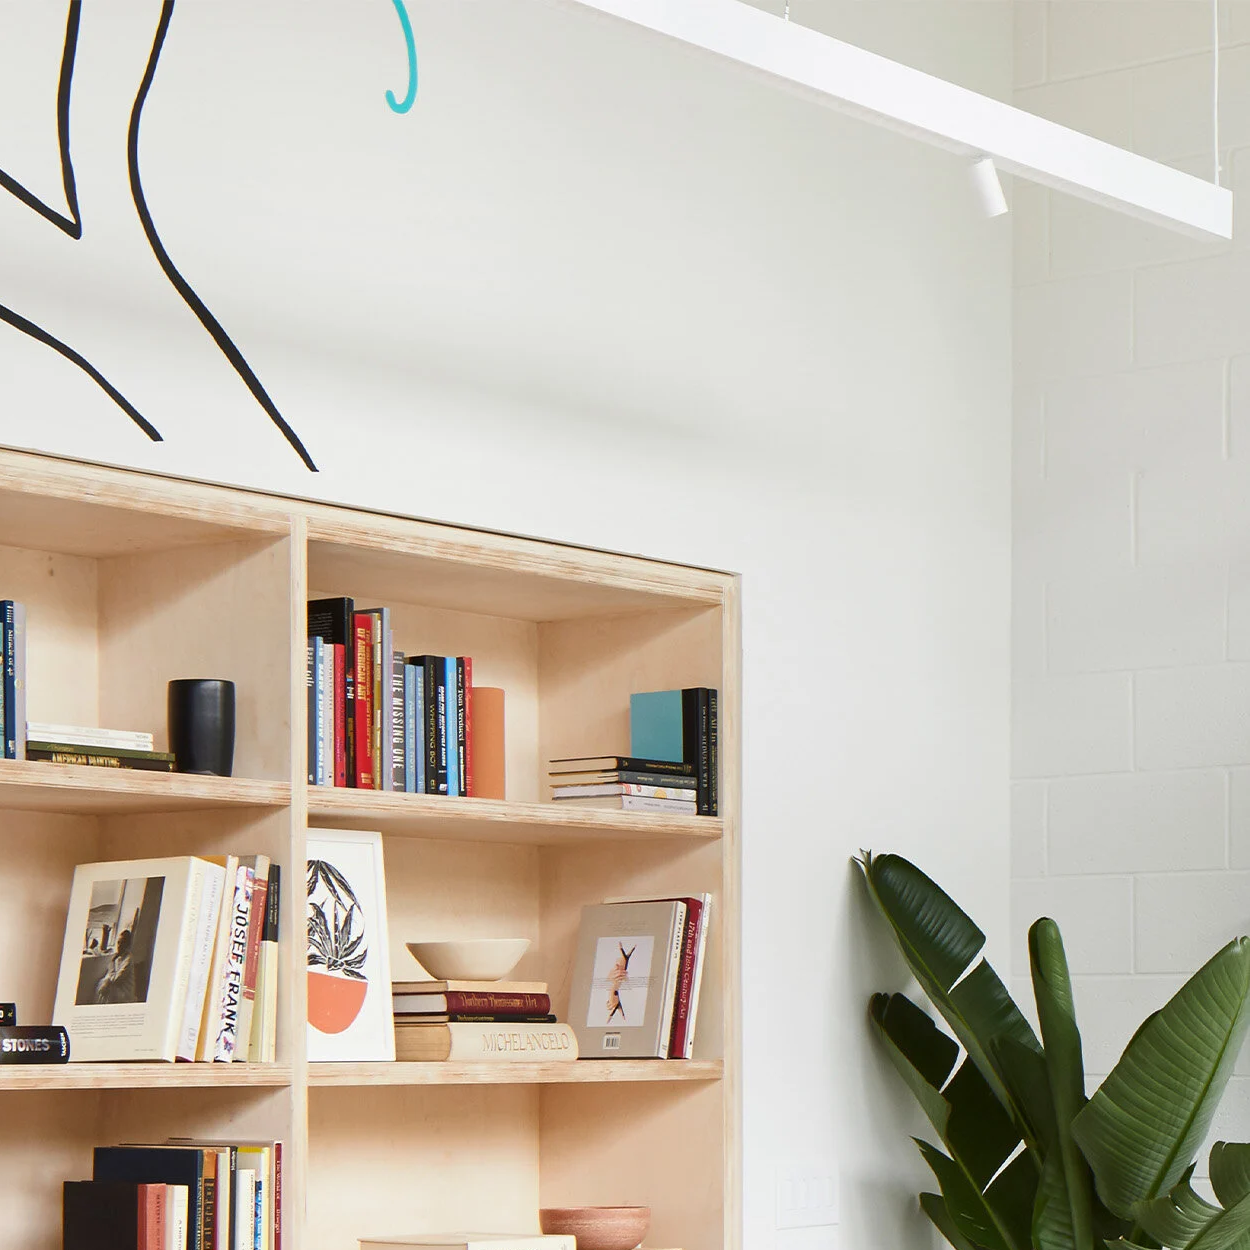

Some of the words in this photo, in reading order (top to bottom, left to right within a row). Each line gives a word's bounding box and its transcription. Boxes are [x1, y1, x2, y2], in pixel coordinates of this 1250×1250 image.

[357, 628, 365, 638] OF
[357, 640, 365, 681] AMERICAN
[358, 684, 366, 700] ART
[393, 674, 403, 692] THE
[393, 698, 403, 743] MISSING
[394, 749, 403, 768] ONE
[231, 904, 248, 964] JOSEF
[224, 970, 240, 1035] FRANK
[2, 1039, 50, 1051] STONES
[482, 1033, 569, 1051] MICHELANGELO
